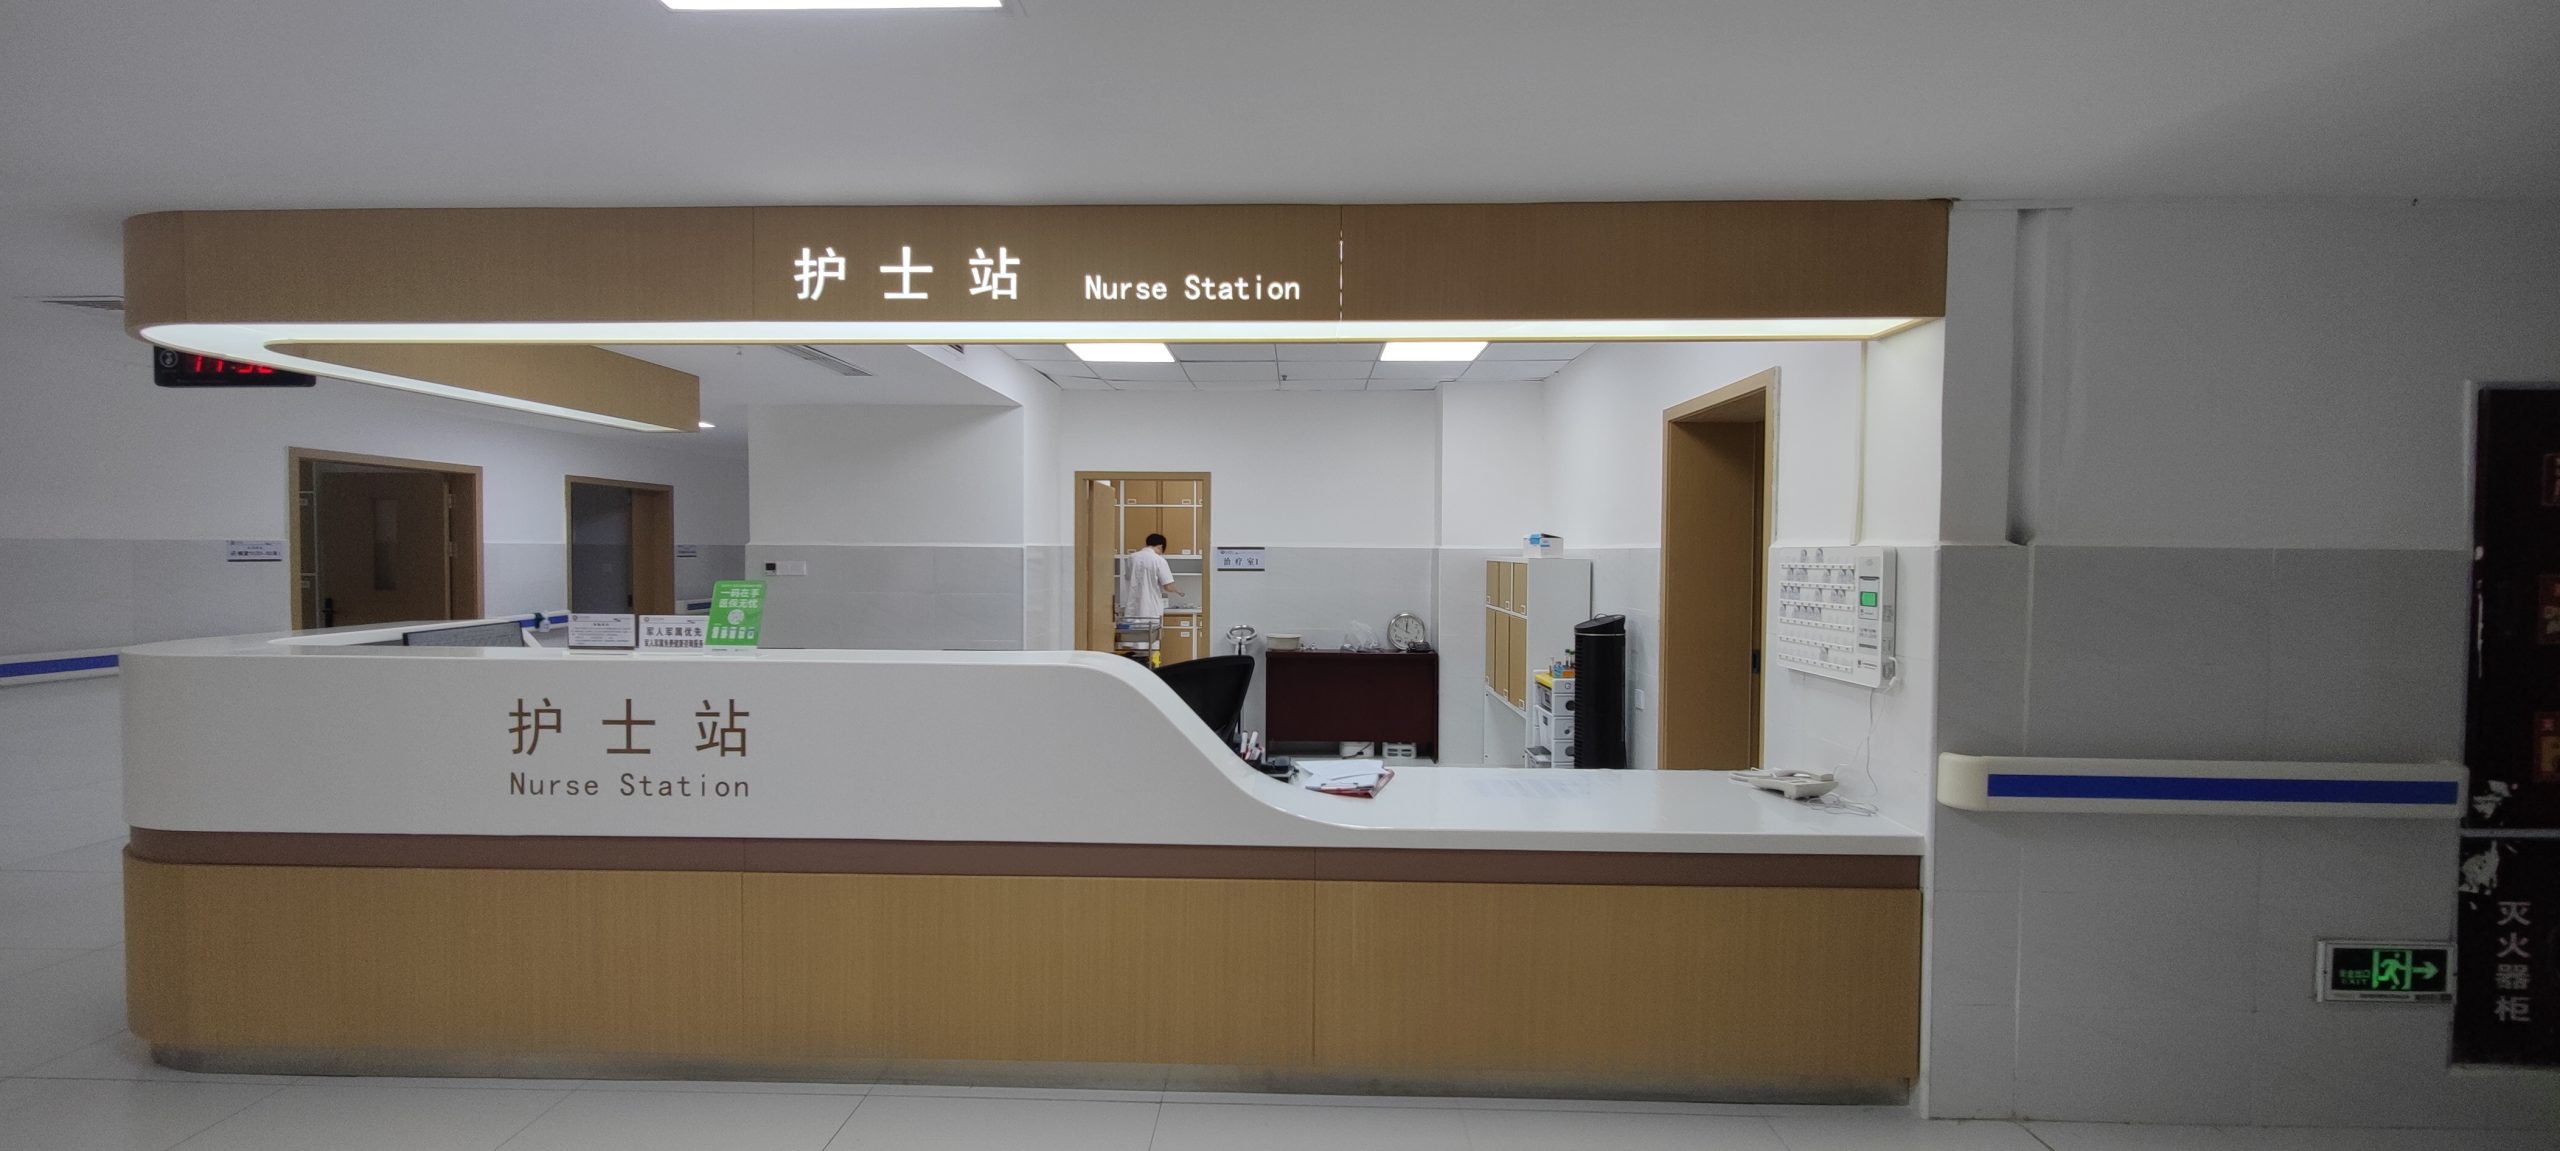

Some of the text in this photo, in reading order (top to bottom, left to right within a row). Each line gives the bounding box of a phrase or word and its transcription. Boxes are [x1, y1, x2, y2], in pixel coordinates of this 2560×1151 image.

[794, 246, 1020, 300] 护士站
[1084, 275, 1301, 300] Nurse Station
[646, 627, 703, 637] 军人军属优先
[508, 698, 749, 757] 护士站
[510, 772, 749, 798] Nurse Station
[2494, 900, 2533, 1023] 灭火器柜
